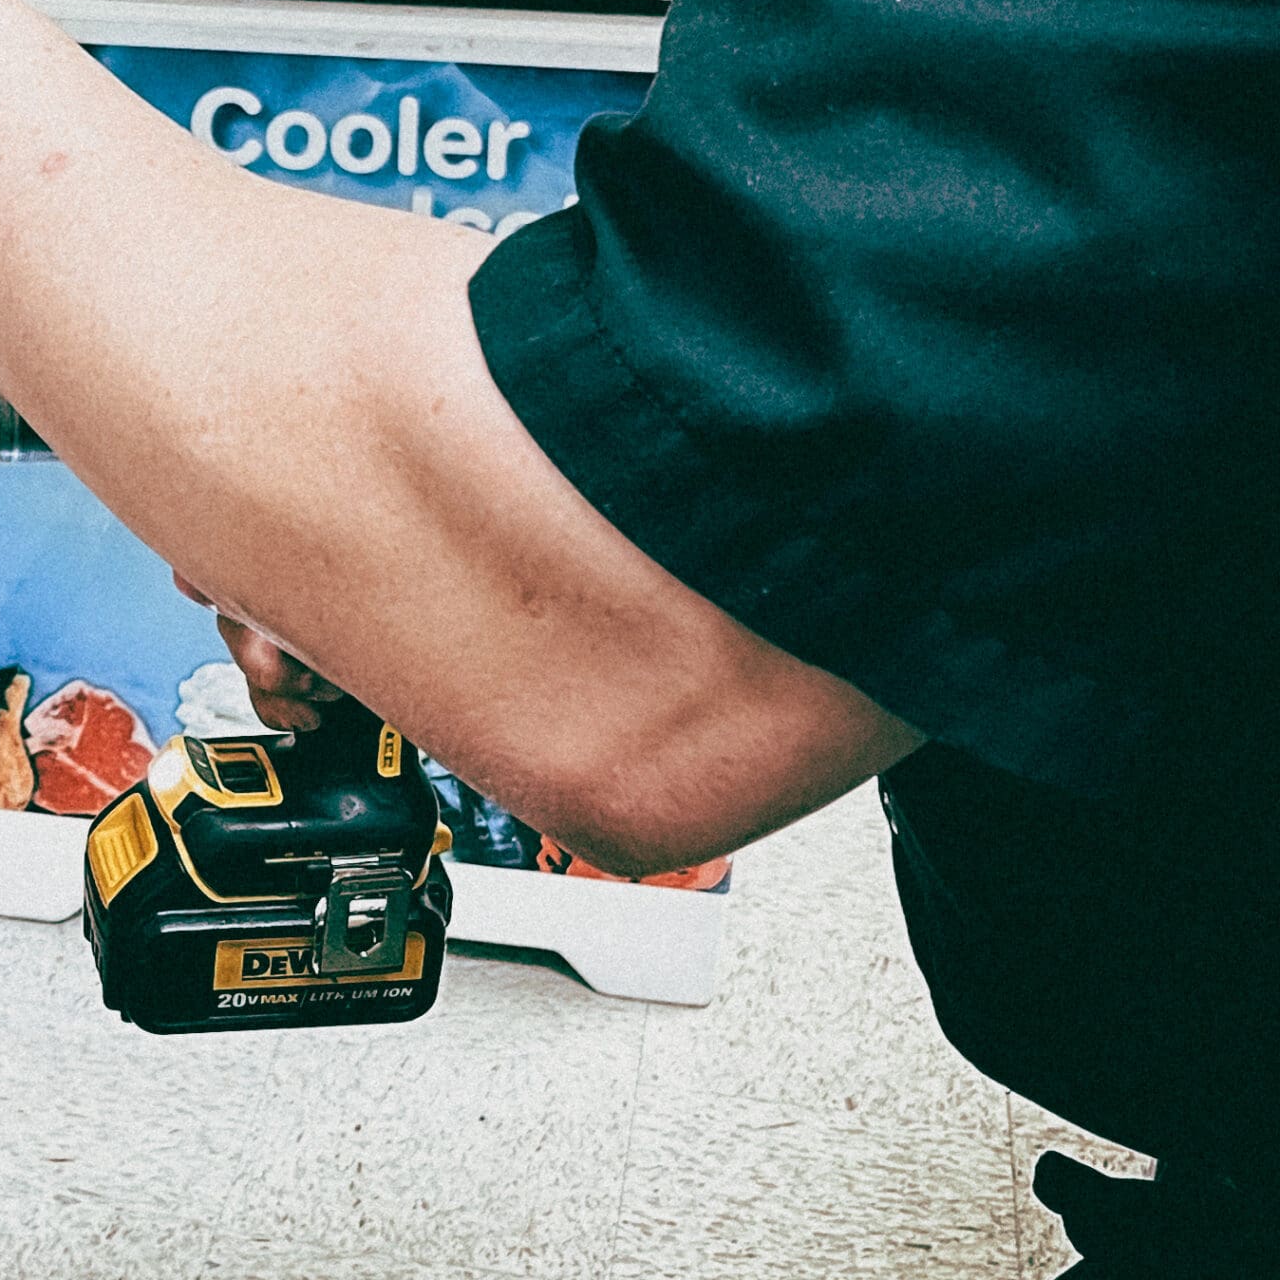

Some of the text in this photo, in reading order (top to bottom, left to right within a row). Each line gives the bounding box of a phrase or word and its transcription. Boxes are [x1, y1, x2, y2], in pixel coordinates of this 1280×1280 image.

[190, 87, 529, 180] Cooler
[242, 951, 313, 977] DEW
[260, 994, 299, 1004] MAX
[310, 990, 378, 1001] LITHUM
[382, 987, 413, 998] ION
